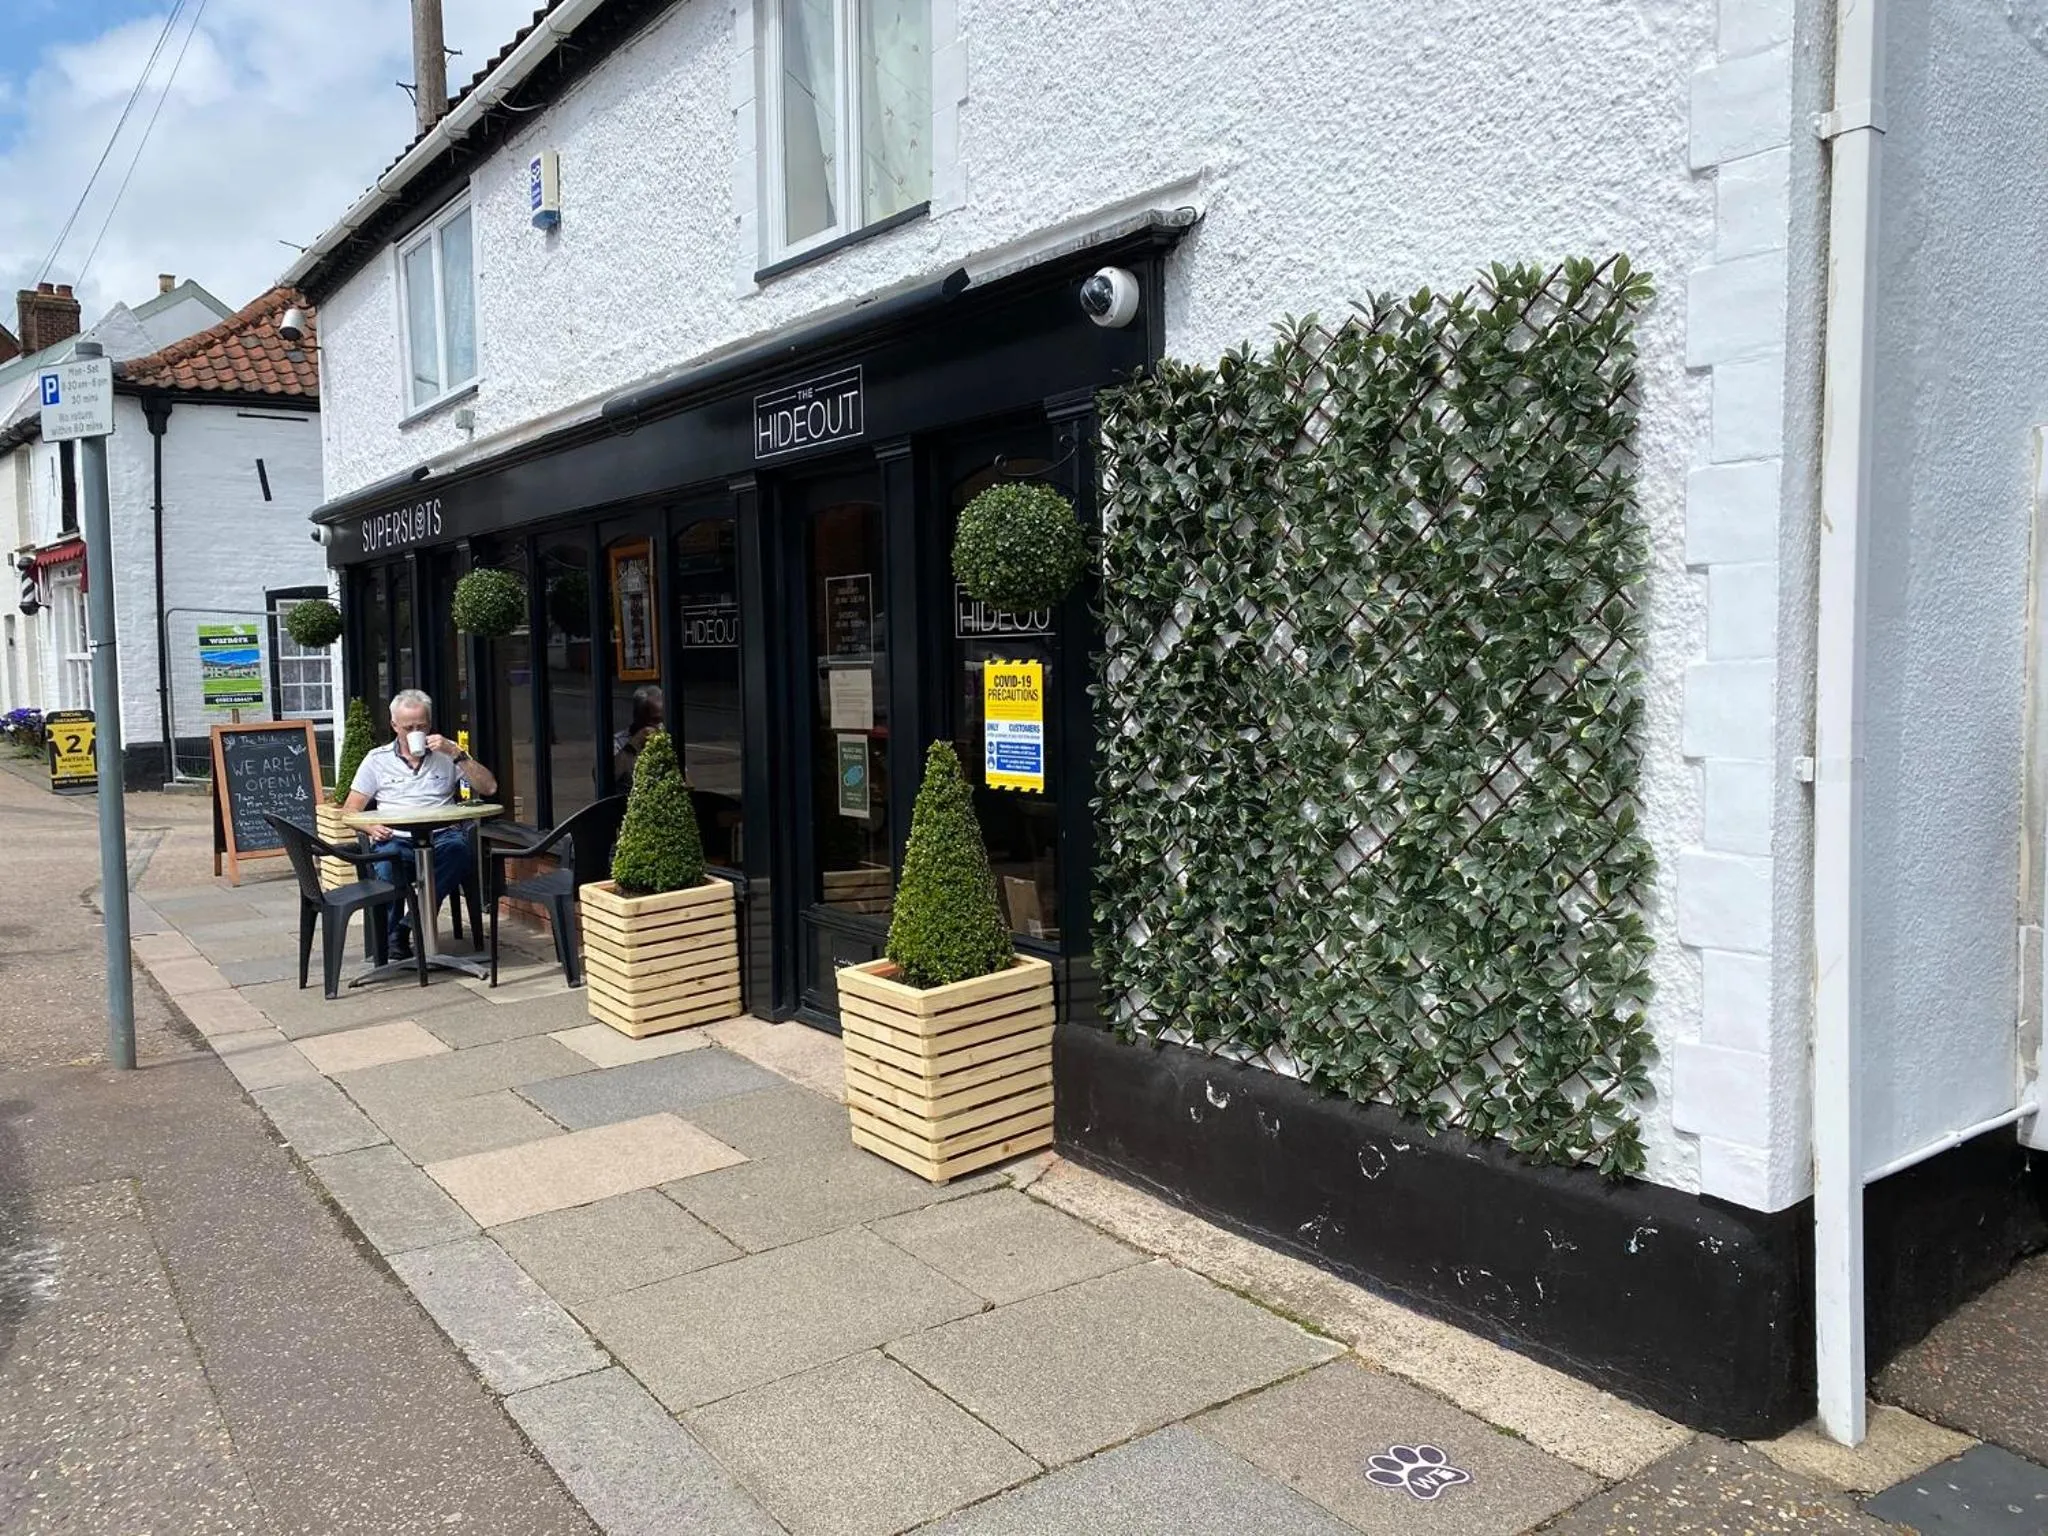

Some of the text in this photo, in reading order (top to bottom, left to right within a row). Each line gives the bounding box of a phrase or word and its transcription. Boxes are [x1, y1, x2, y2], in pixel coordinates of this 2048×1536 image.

[45, 378, 57, 403] P
[797, 387, 813, 400] THE
[758, 390, 858, 451] HIDEOUT
[362, 498, 441, 552] SUPERSLOTS
[959, 602, 1050, 633] HIDEOU
[993, 675, 1032, 687] COVID-19
[987, 688, 1039, 702] PRECAUTIONS
[1008, 724, 1040, 733] CUSTOMERS
[65, 734, 83, 753] 2
[232, 756, 294, 776] WE ARE
